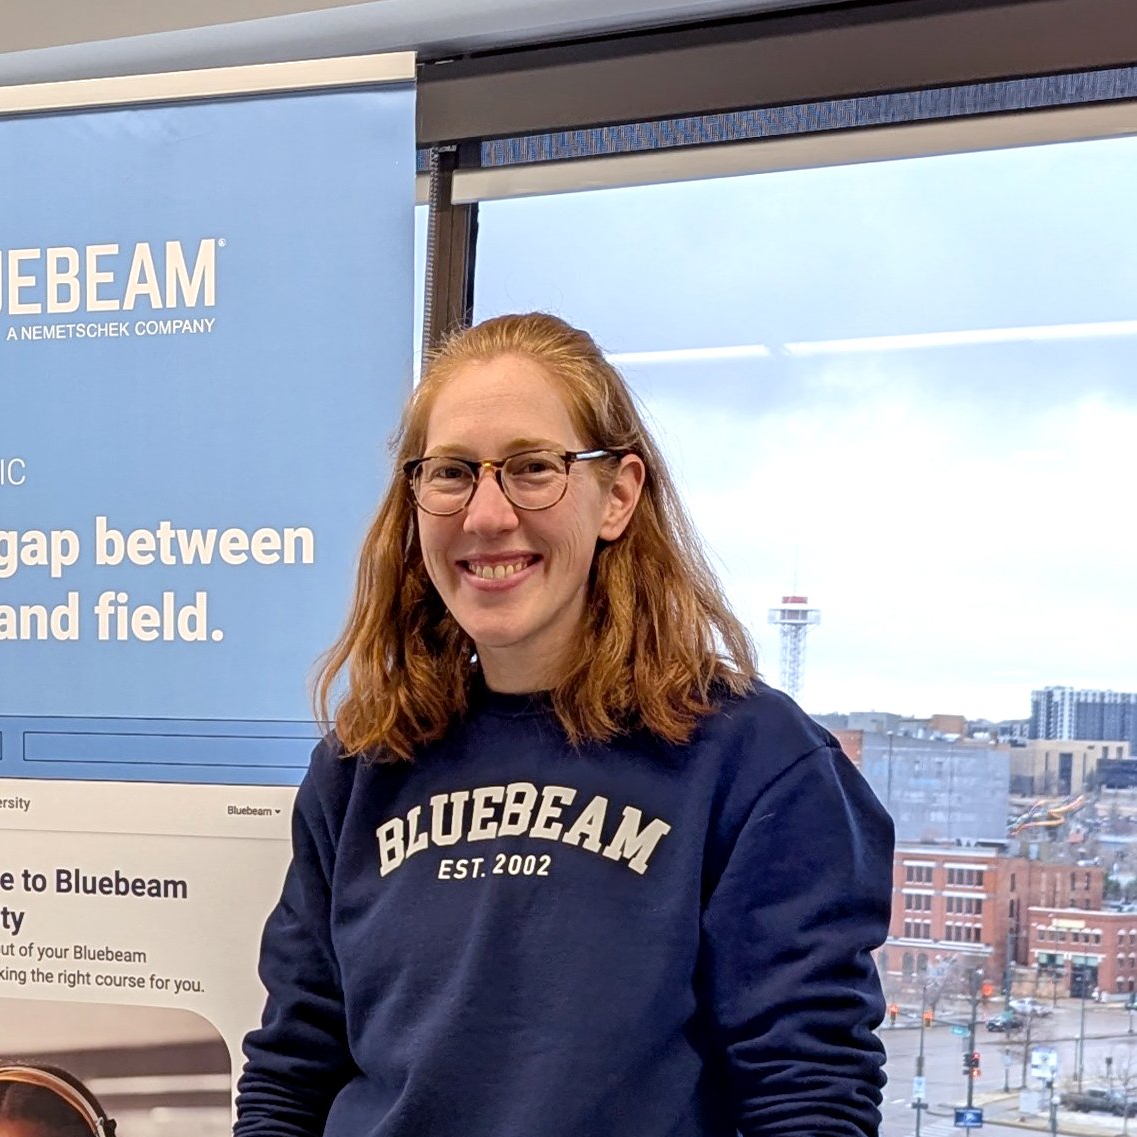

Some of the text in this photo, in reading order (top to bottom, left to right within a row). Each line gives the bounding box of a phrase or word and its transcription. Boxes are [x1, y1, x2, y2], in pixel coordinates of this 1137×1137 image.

[6, 318, 216, 341] A NEMETSCHEK COMPANY
[95, 516, 314, 565] between
[94, 591, 224, 642] field.
[227, 805, 272, 817] Bluebeam
[376, 782, 672, 877] BLUEBEAM
[437, 853, 552, 880] EST. 2002
[22, 869, 47, 893] to
[55, 868, 188, 899] Bluebeam
[18, 942, 34, 958] of
[37, 946, 70, 962] your
[73, 945, 147, 963] Bluebeam
[31, 967, 54, 984] the
[58, 969, 91, 989] right
[95, 973, 146, 989] course
[149, 973, 170, 990] for
[173, 979, 206, 995] you.
